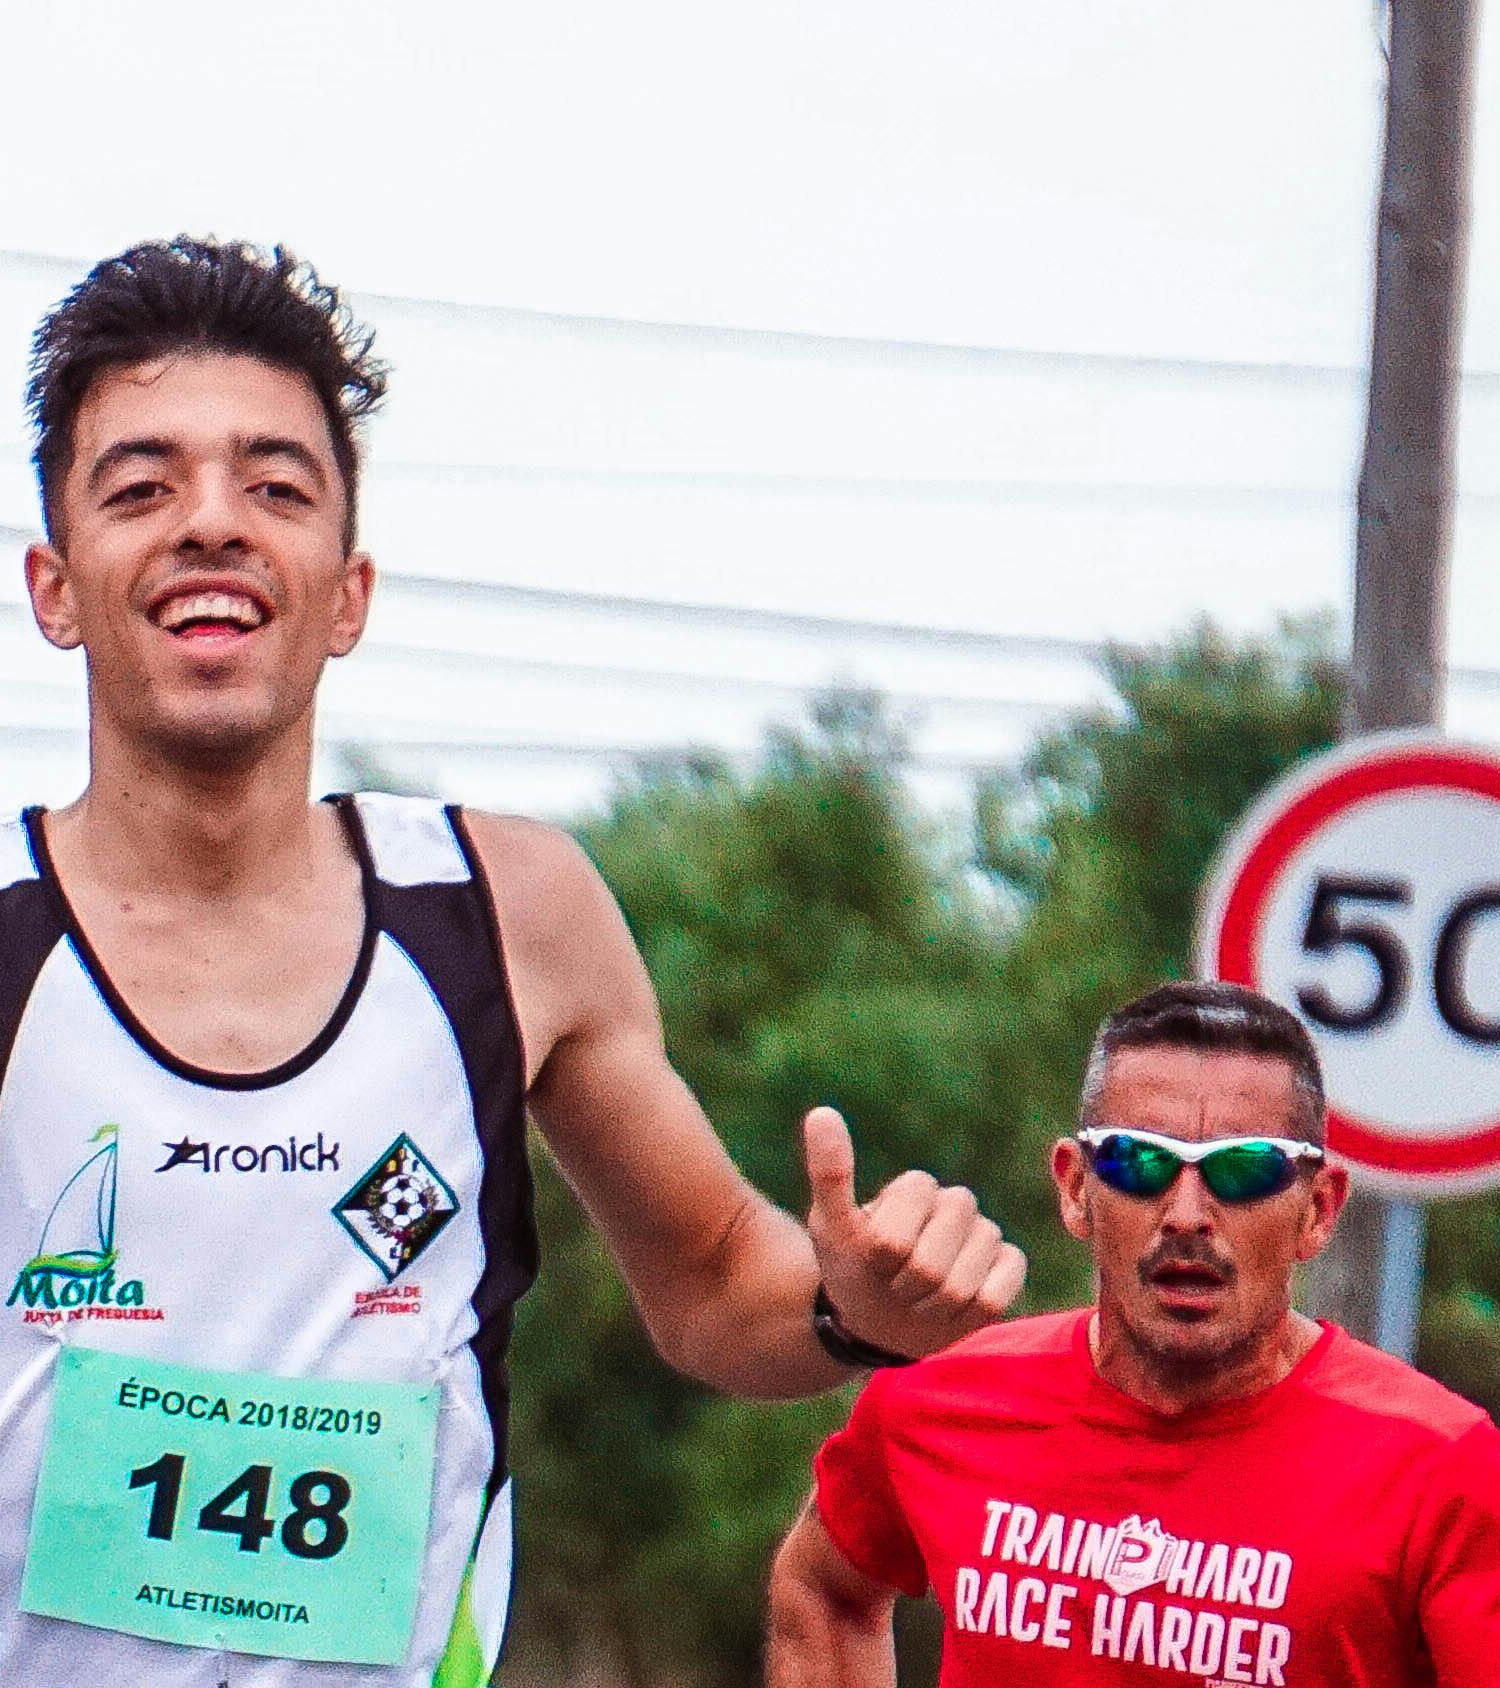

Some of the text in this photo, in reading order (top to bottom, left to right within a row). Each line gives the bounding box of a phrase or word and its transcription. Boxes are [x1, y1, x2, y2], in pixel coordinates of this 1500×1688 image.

[118, 1377, 382, 1436] ÉPOCA 2018/2019
[128, 1452, 351, 1561] 148
[981, 1499, 1293, 1610] TRAIN HARD
[135, 1584, 310, 1624] ATLETISMOITA
[956, 1566, 1291, 1687] RACE HARDER
